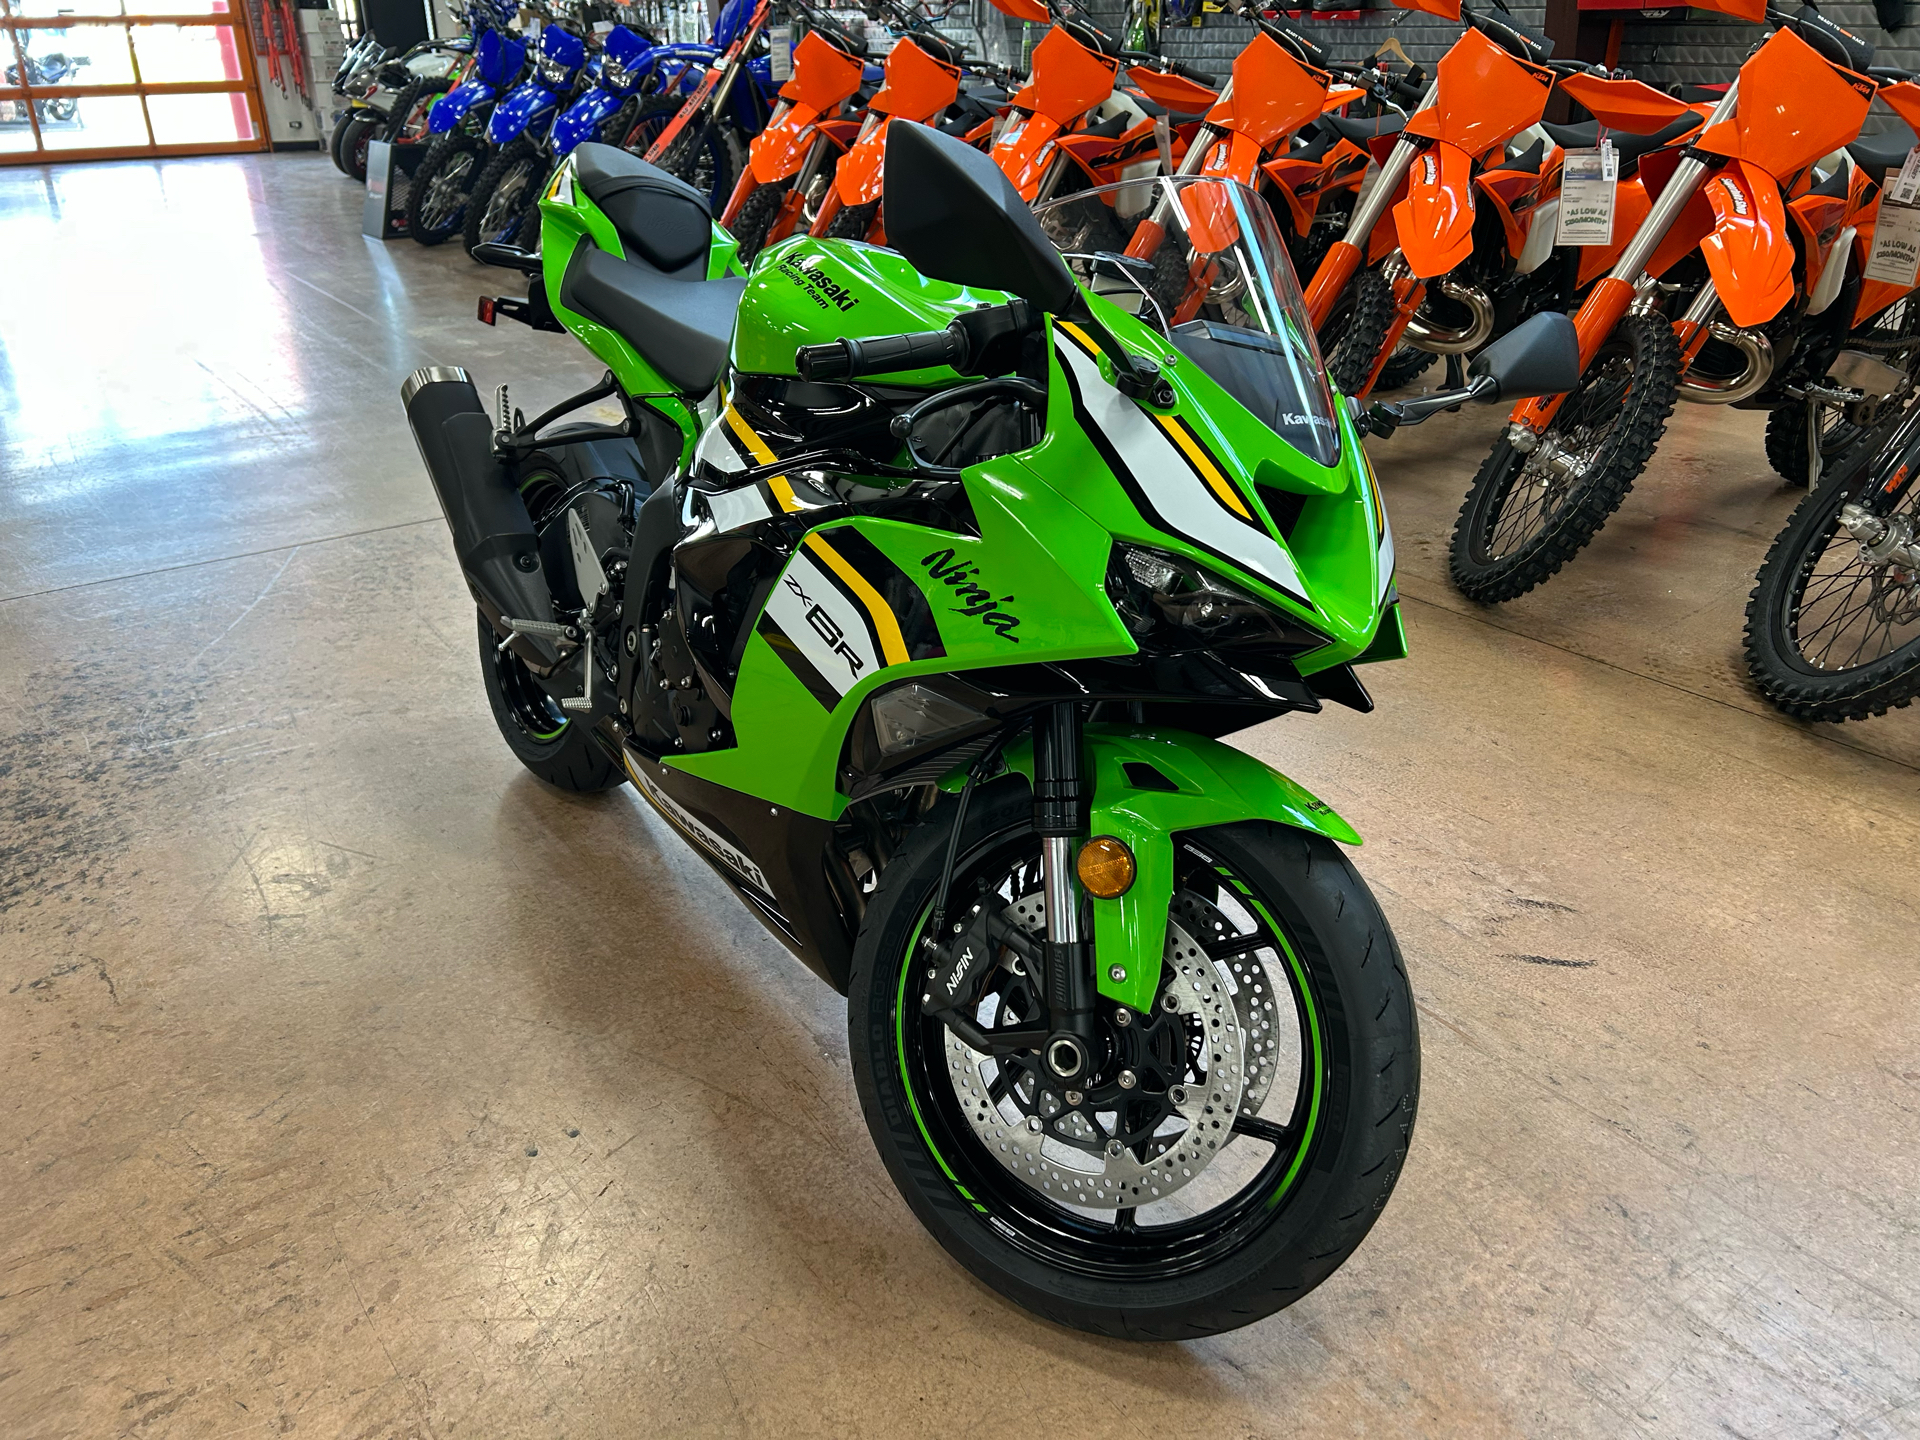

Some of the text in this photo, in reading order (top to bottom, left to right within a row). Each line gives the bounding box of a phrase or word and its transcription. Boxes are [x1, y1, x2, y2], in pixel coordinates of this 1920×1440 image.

[1285, 28, 1298, 39] READY
[1311, 44, 1322, 54] RACE
[1817, 15, 1833, 27] READY
[1851, 36, 1866, 46] RACE
[1530, 41, 1542, 51] RACE
[1311, 74, 1326, 84] KTM
[1532, 72, 1549, 82] KTM
[1851, 82, 1870, 94] KTM
[1580, 207, 1597, 215] LOW
[1598, 209, 1607, 217] AS
[1892, 240, 1908, 249] LOW
[775, 264, 829, 309] Racing Team
[781, 251, 860, 312] Kawasaki
[921, 548, 1020, 643] Ninja
[783, 573, 863, 680] ZX-6R
[644, 776, 764, 889] Kawasaki
[871, 1028, 901, 1127] DIABLO
